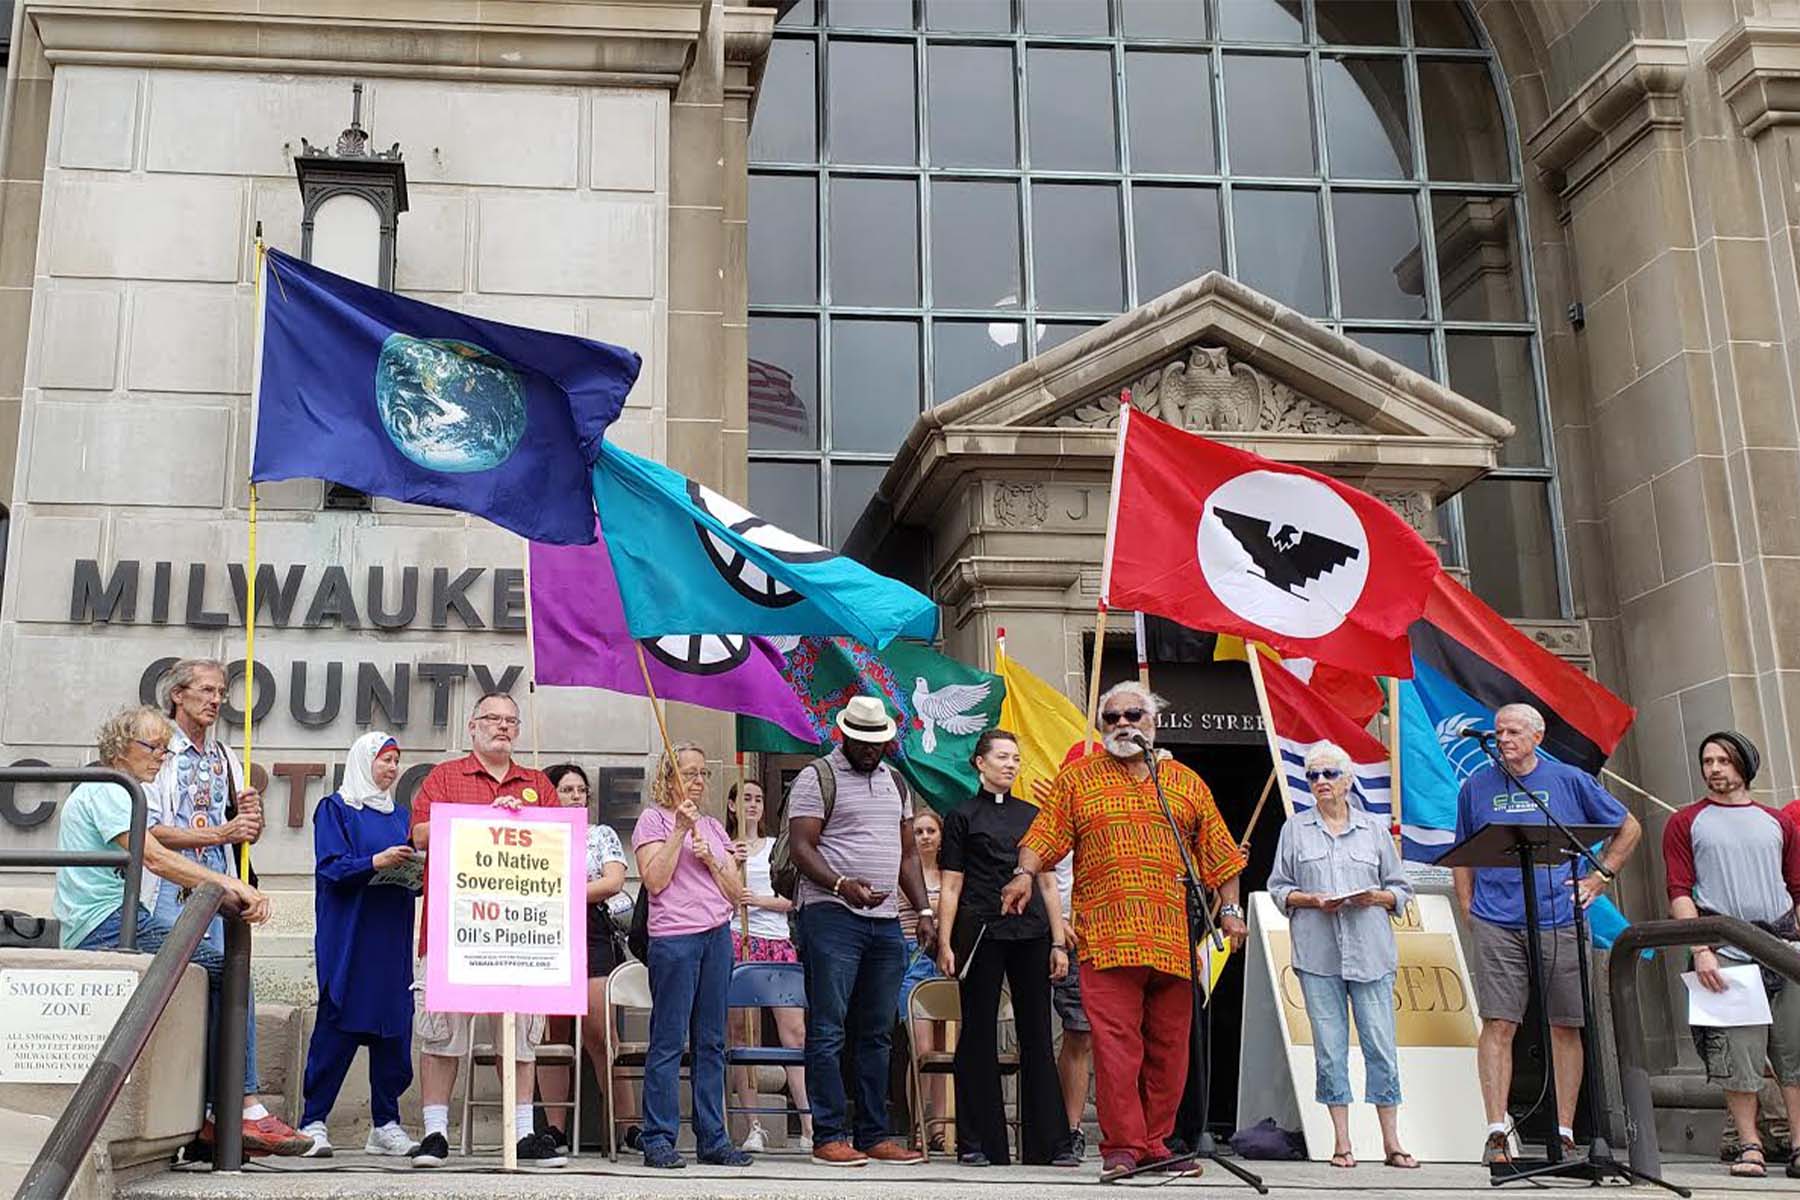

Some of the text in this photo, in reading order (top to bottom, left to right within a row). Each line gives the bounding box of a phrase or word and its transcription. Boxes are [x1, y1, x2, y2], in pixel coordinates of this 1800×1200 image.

[69, 558, 527, 629] MILWAUKE
[1156, 712, 1266, 732] LLS STREE
[488, 826, 533, 848] YES
[475, 851, 550, 871] to Native
[456, 872, 562, 897] Sovereignty!
[472, 901, 548, 926] NO to Big
[456, 928, 562, 947] Oil's Pipeline!
[9, 982, 127, 997] SMOKE FREE
[41, 1002, 92, 1017] ZONE
[6, 1033, 24, 1041] ALL
[25, 1033, 68, 1041] SMOKING
[69, 1033, 94, 1041] MUST
[7, 1042, 35, 1050] LEAST
[47, 1043, 71, 1051] FEET
[72, 1043, 100, 1051] FROM
[14, 1061, 58, 1070] BUILDING
[15, 1052, 96, 1060] MILWAUKEE COUN
